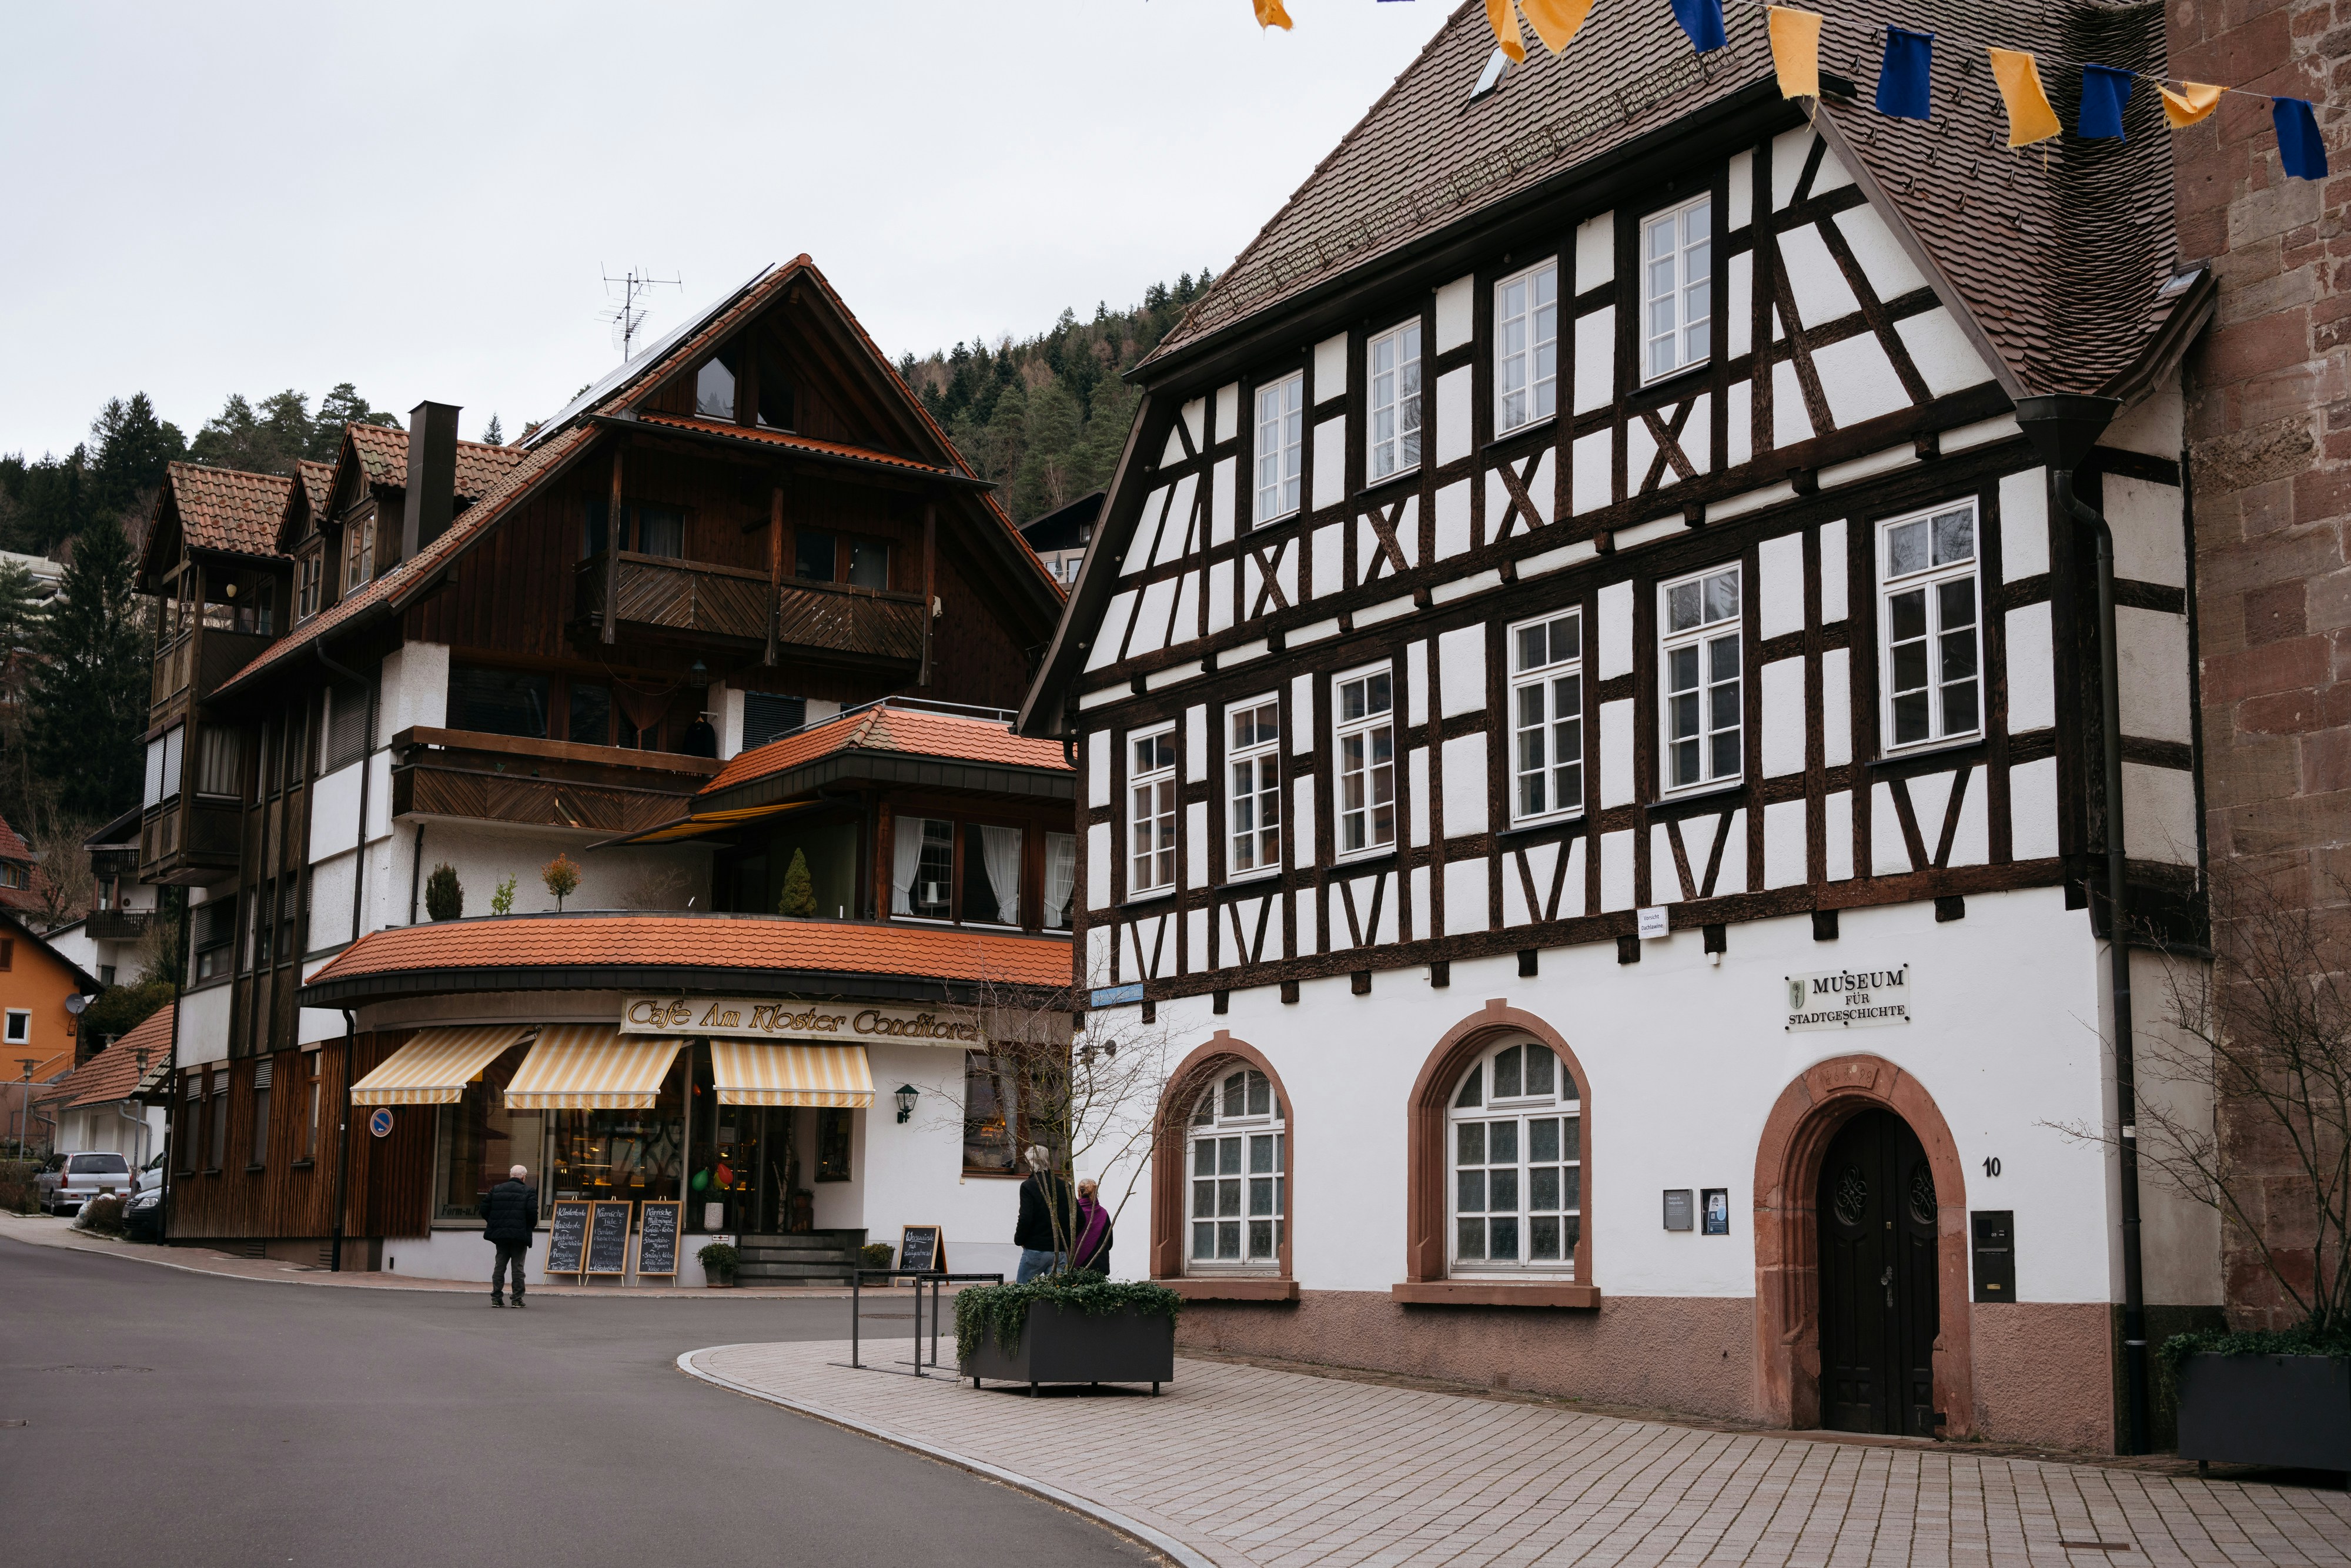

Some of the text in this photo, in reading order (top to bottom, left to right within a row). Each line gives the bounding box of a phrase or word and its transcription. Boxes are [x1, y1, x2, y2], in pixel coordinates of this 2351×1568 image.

[1812, 970, 1904, 994] MUSEUM
[1845, 992, 1870, 1005] FÜR
[628, 1000, 980, 1041] Cafe Am Kloster Conditorei
[1789, 1005, 1905, 1024] STADTGESCHICHTE
[1982, 1156, 2001, 1177] 10
